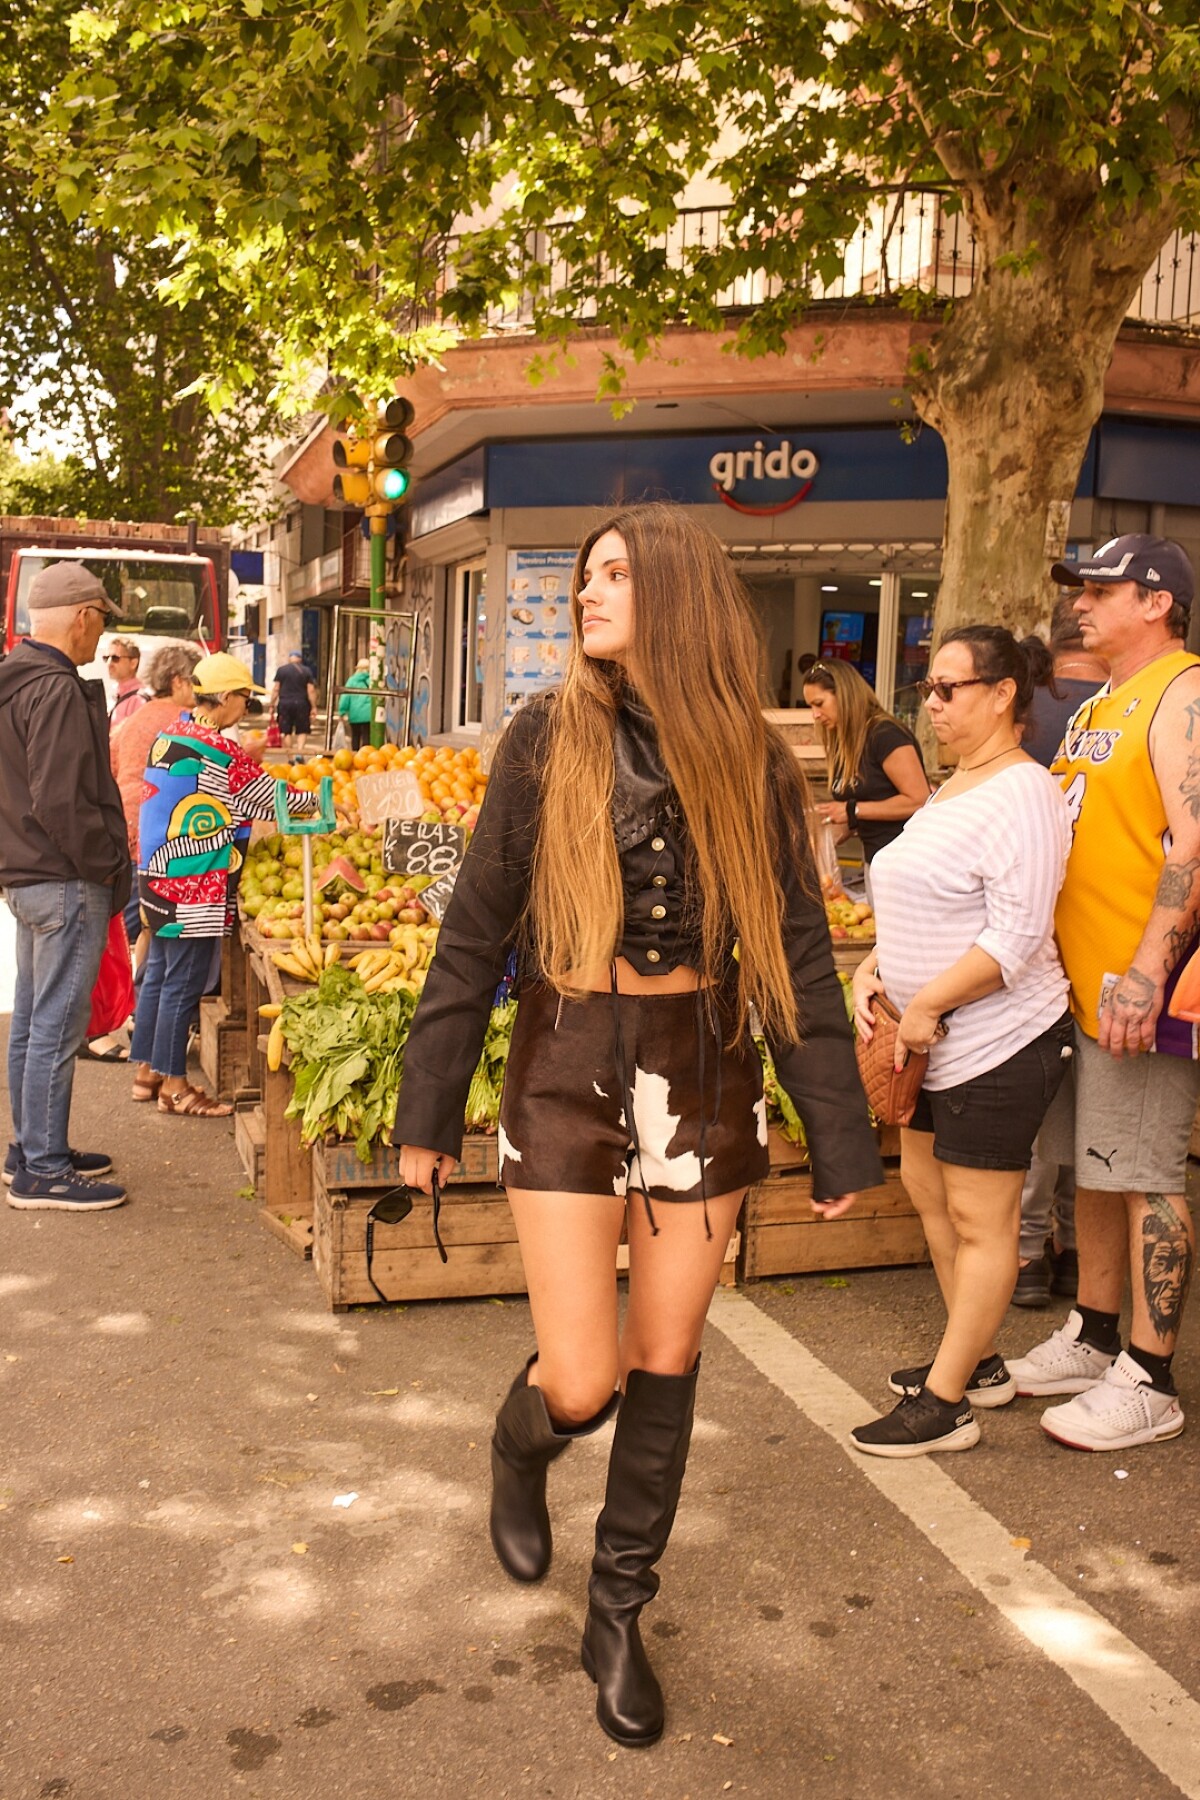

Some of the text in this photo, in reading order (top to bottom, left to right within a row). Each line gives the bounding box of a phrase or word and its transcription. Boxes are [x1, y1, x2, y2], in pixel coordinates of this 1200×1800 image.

[709, 440, 817, 491] grido
[389, 819, 459, 844] PERAS
[406, 841, 458, 875] 88
